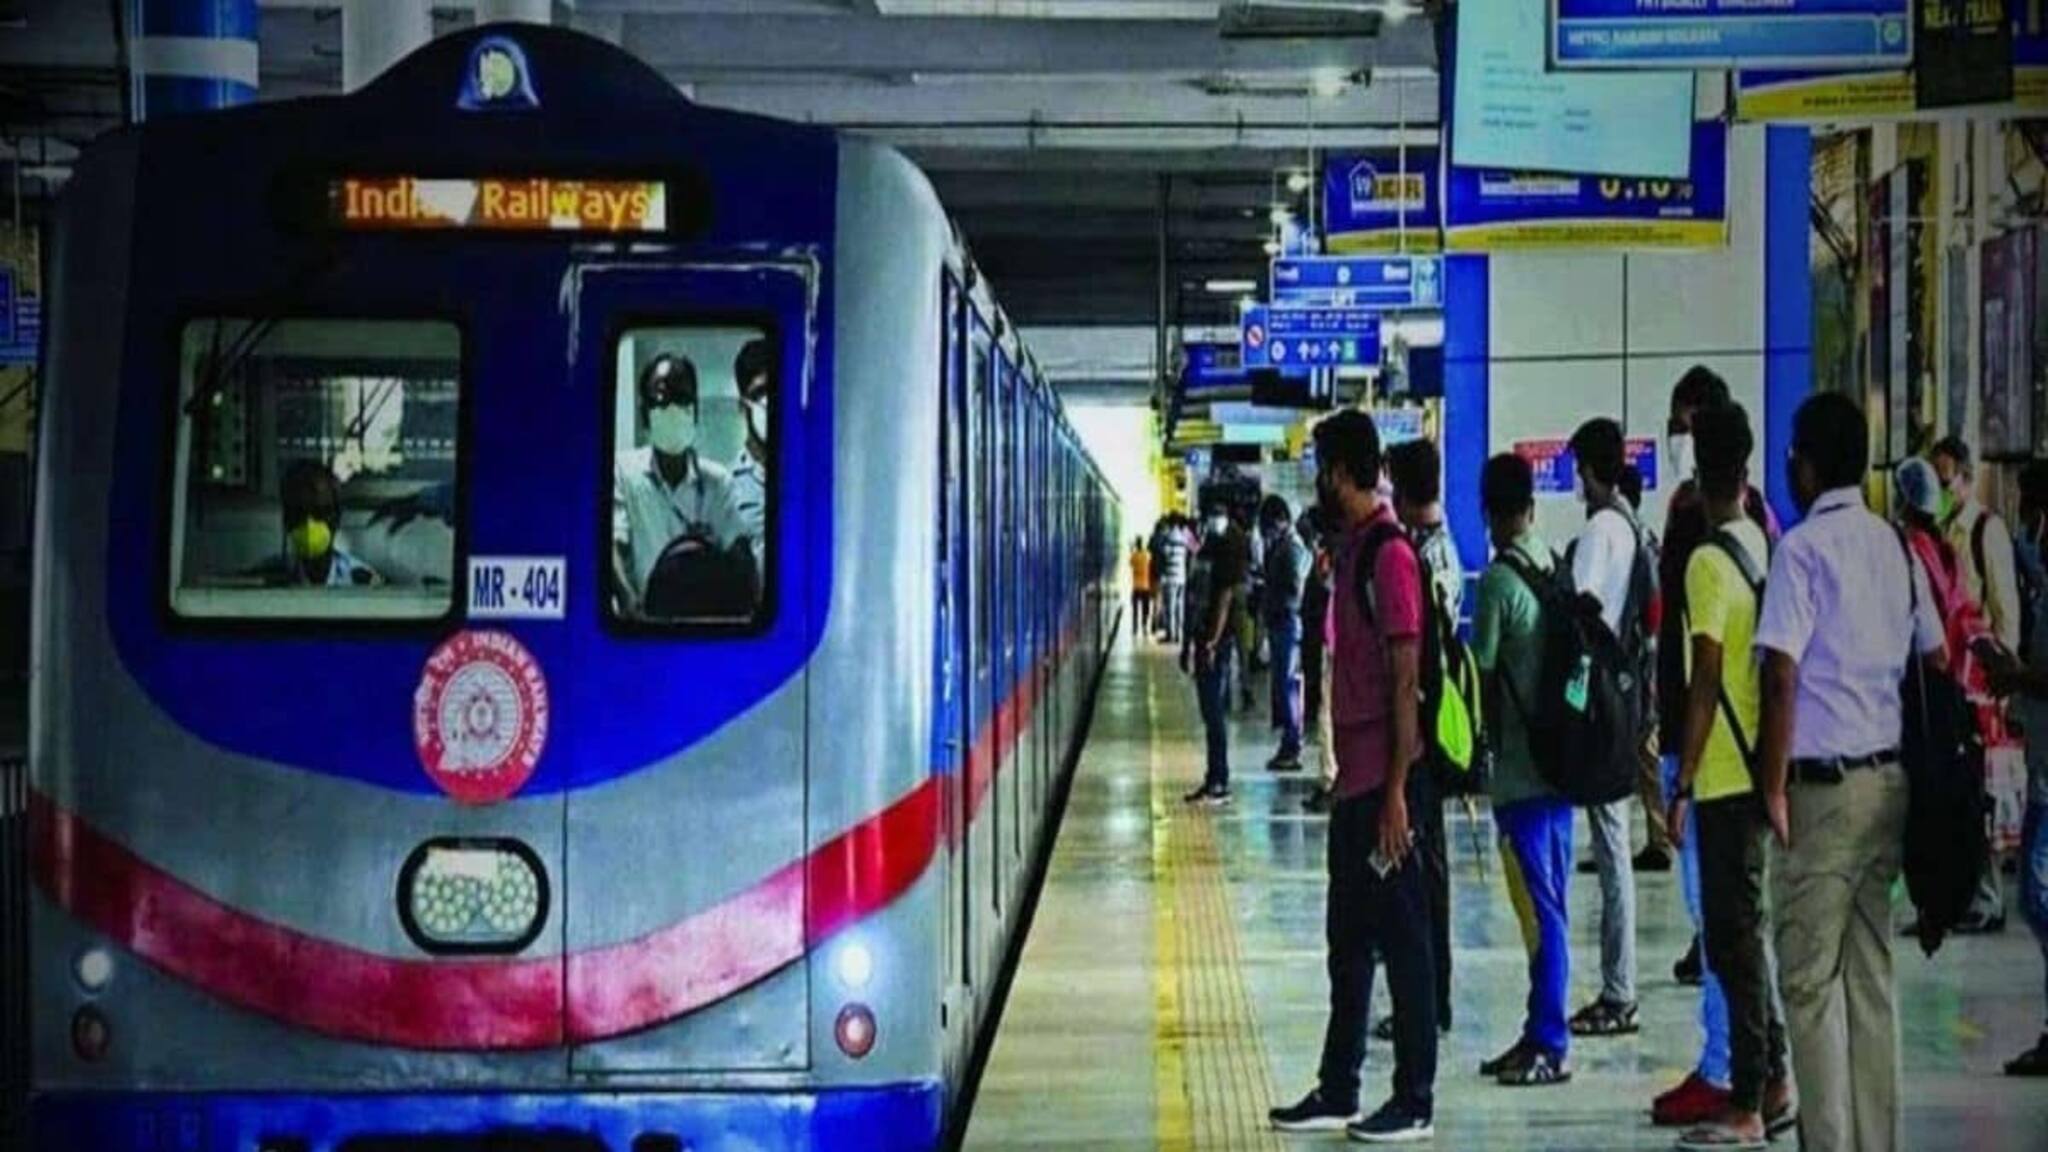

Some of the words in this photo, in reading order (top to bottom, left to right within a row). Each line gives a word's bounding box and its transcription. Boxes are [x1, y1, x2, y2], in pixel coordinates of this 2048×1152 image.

[482, 180, 650, 230] Railways
[473, 564, 505, 609] MR
[522, 564, 560, 609] 404
